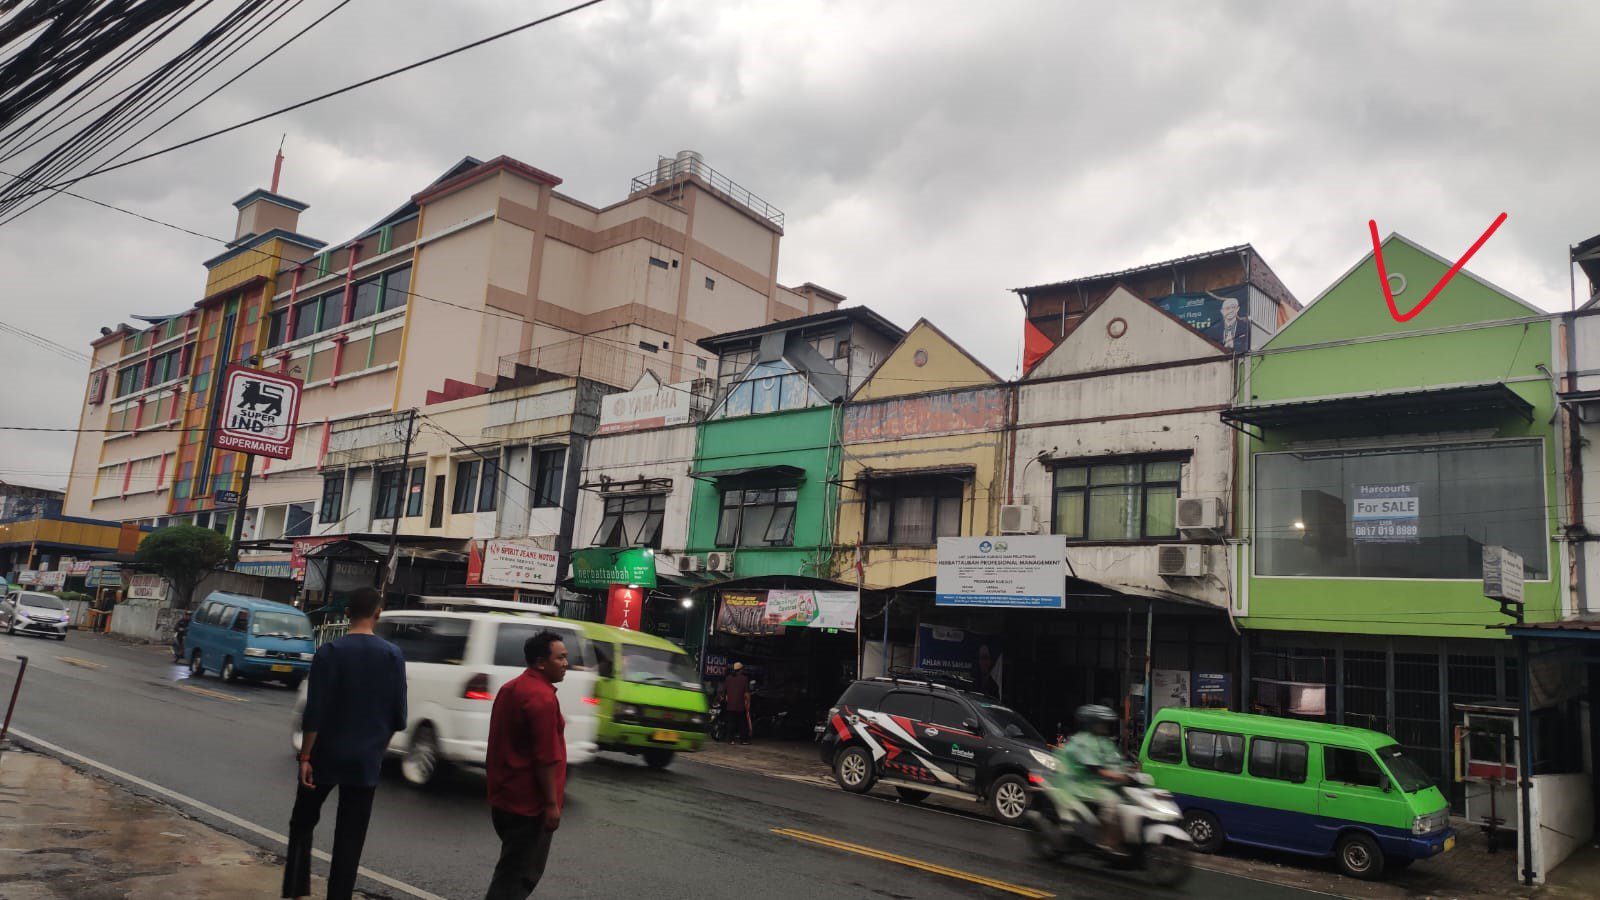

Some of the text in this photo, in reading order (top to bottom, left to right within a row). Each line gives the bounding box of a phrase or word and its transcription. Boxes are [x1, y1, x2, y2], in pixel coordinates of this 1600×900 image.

[1187, 318, 1211, 329] itri
[628, 391, 677, 415] YAMAHA
[240, 409, 275, 423] SUPER
[231, 415, 279, 434] IND
[219, 435, 290, 455] SUPERMARKET
[1361, 485, 1410, 494] Harcourts
[1357, 501, 1415, 513] For SALE
[501, 546, 520, 557] SPIRIT
[538, 552, 556, 562] MOTOR
